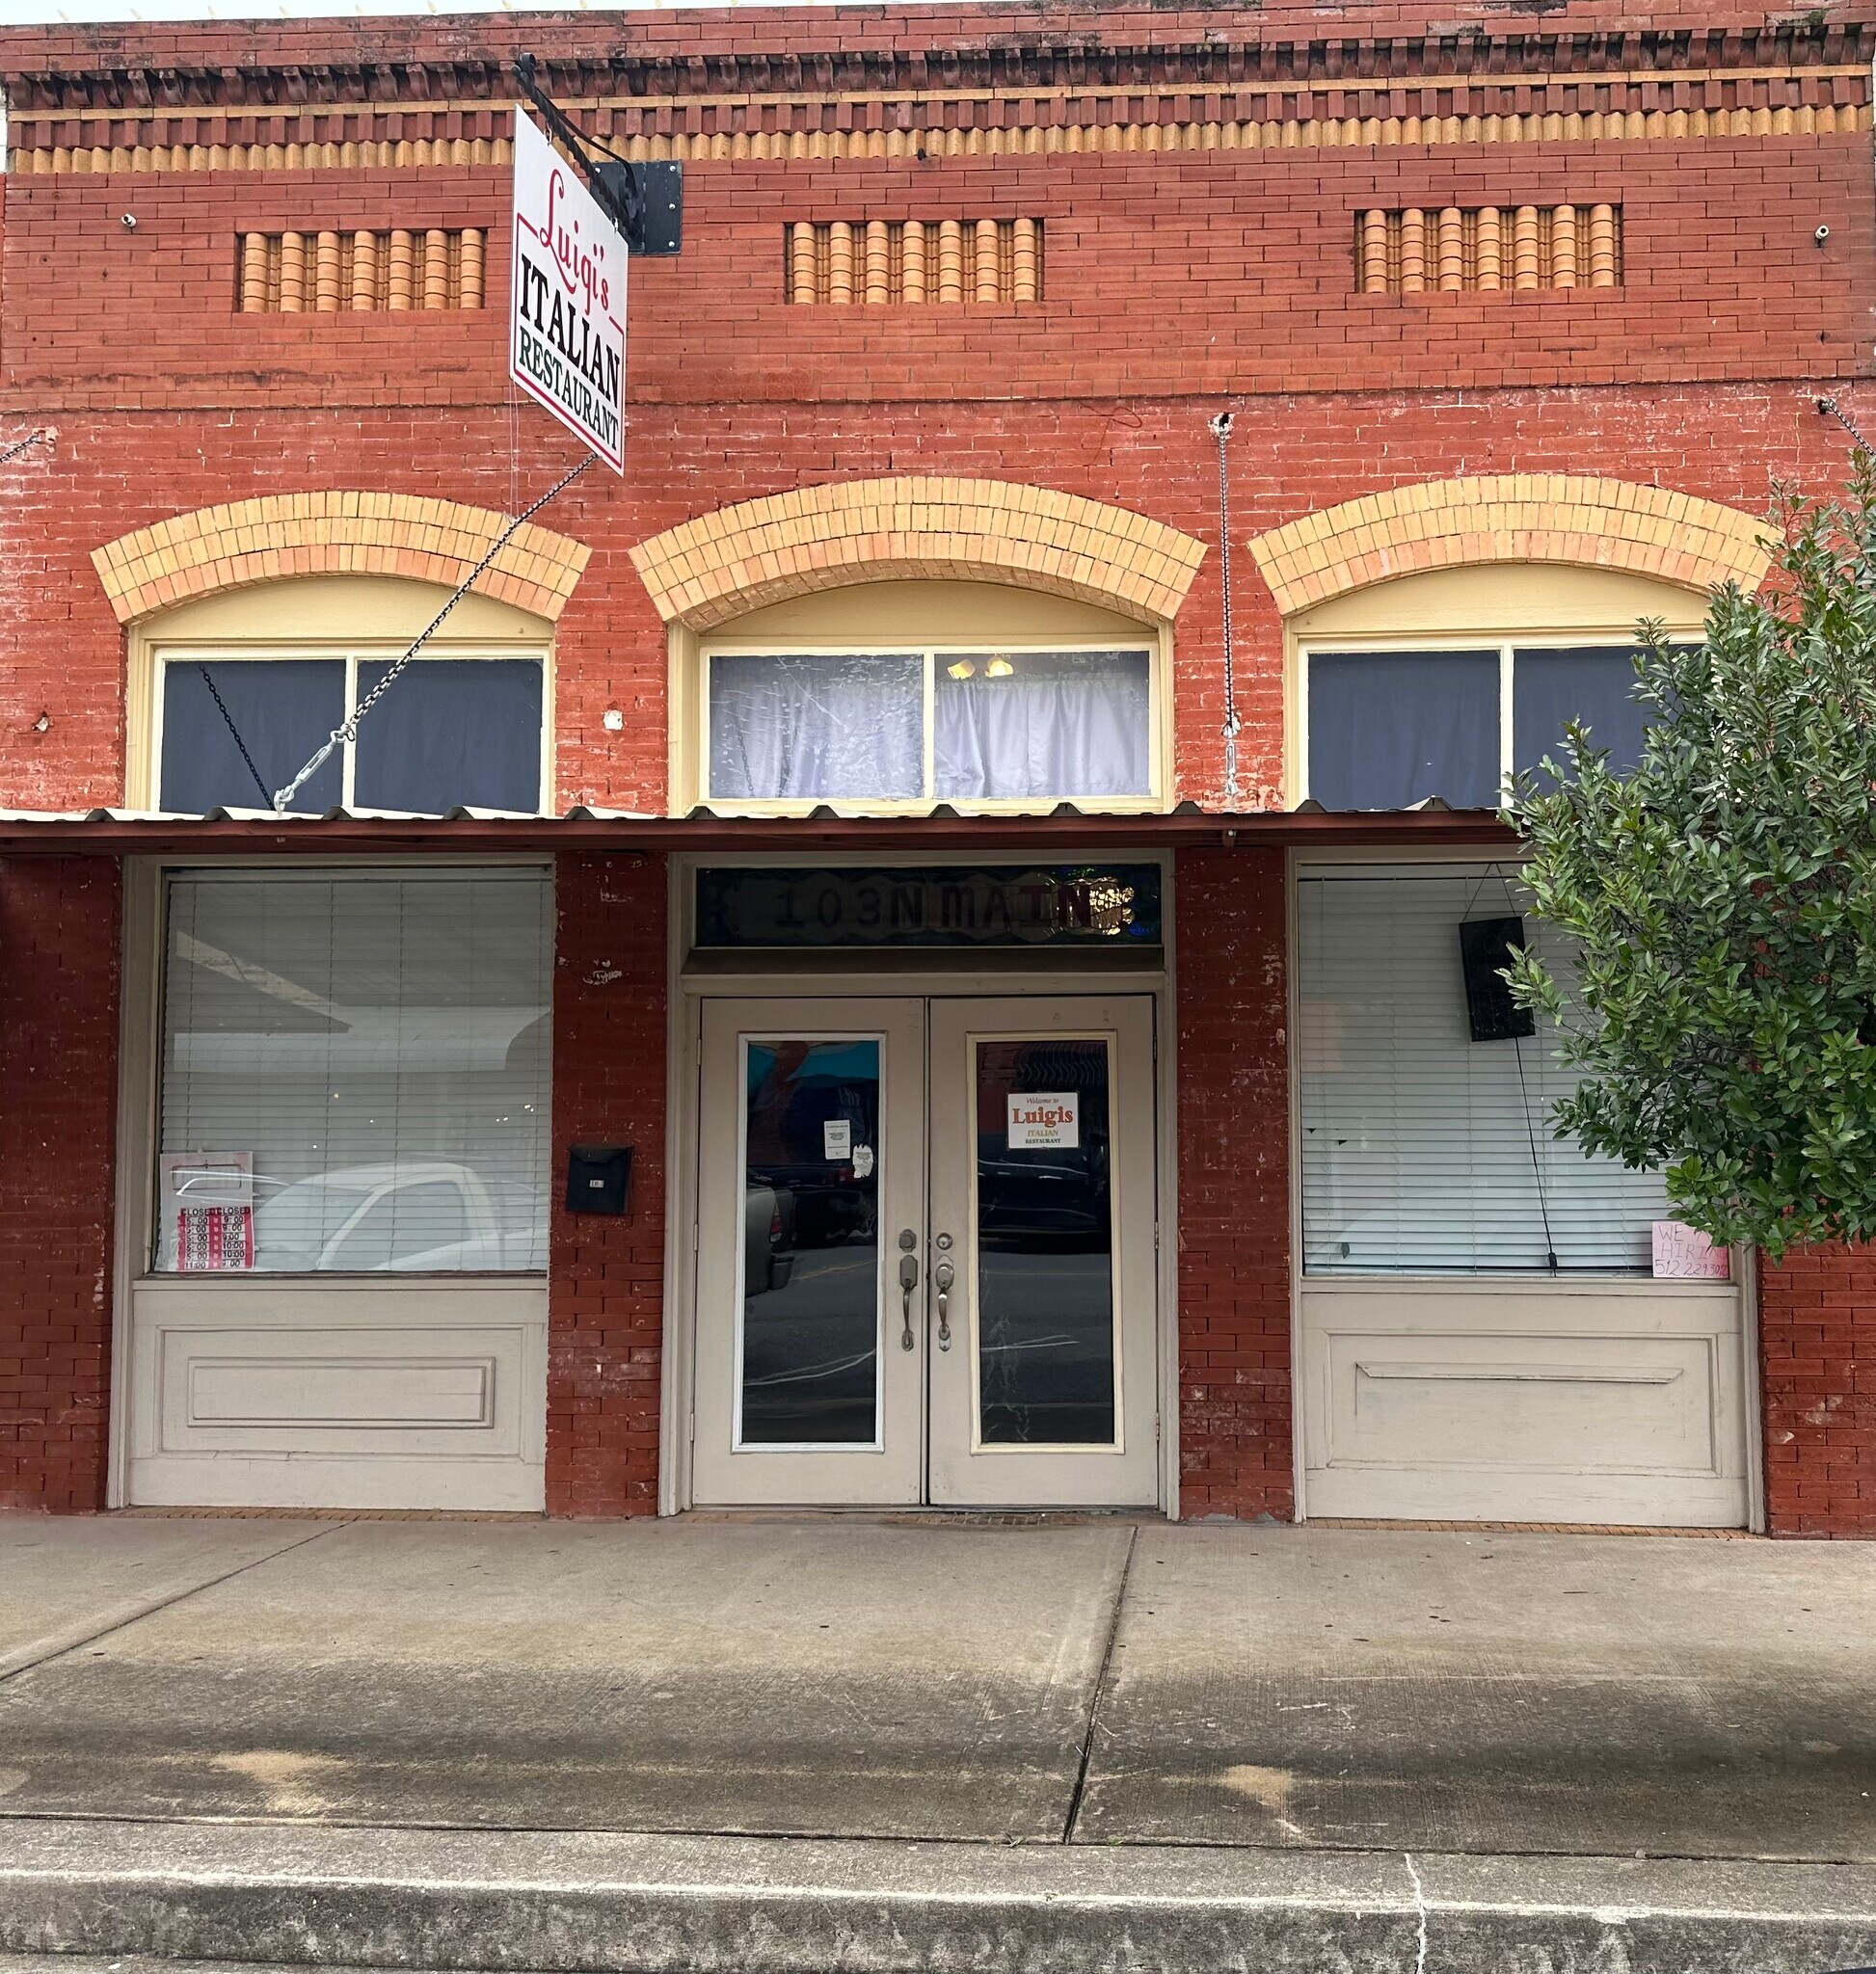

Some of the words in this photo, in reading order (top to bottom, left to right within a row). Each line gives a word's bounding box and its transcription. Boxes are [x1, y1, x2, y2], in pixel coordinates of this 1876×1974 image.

[520, 253, 621, 409] ITALIAN
[519, 324, 620, 452] RESTAURANT
[940, 884, 1093, 929] MAIN
[1012, 1106, 1074, 1128] Luigis
[180, 1208, 216, 1216] CLOSED
[217, 1207, 251, 1215] CLOSED
[1658, 1224, 1684, 1241] WE
